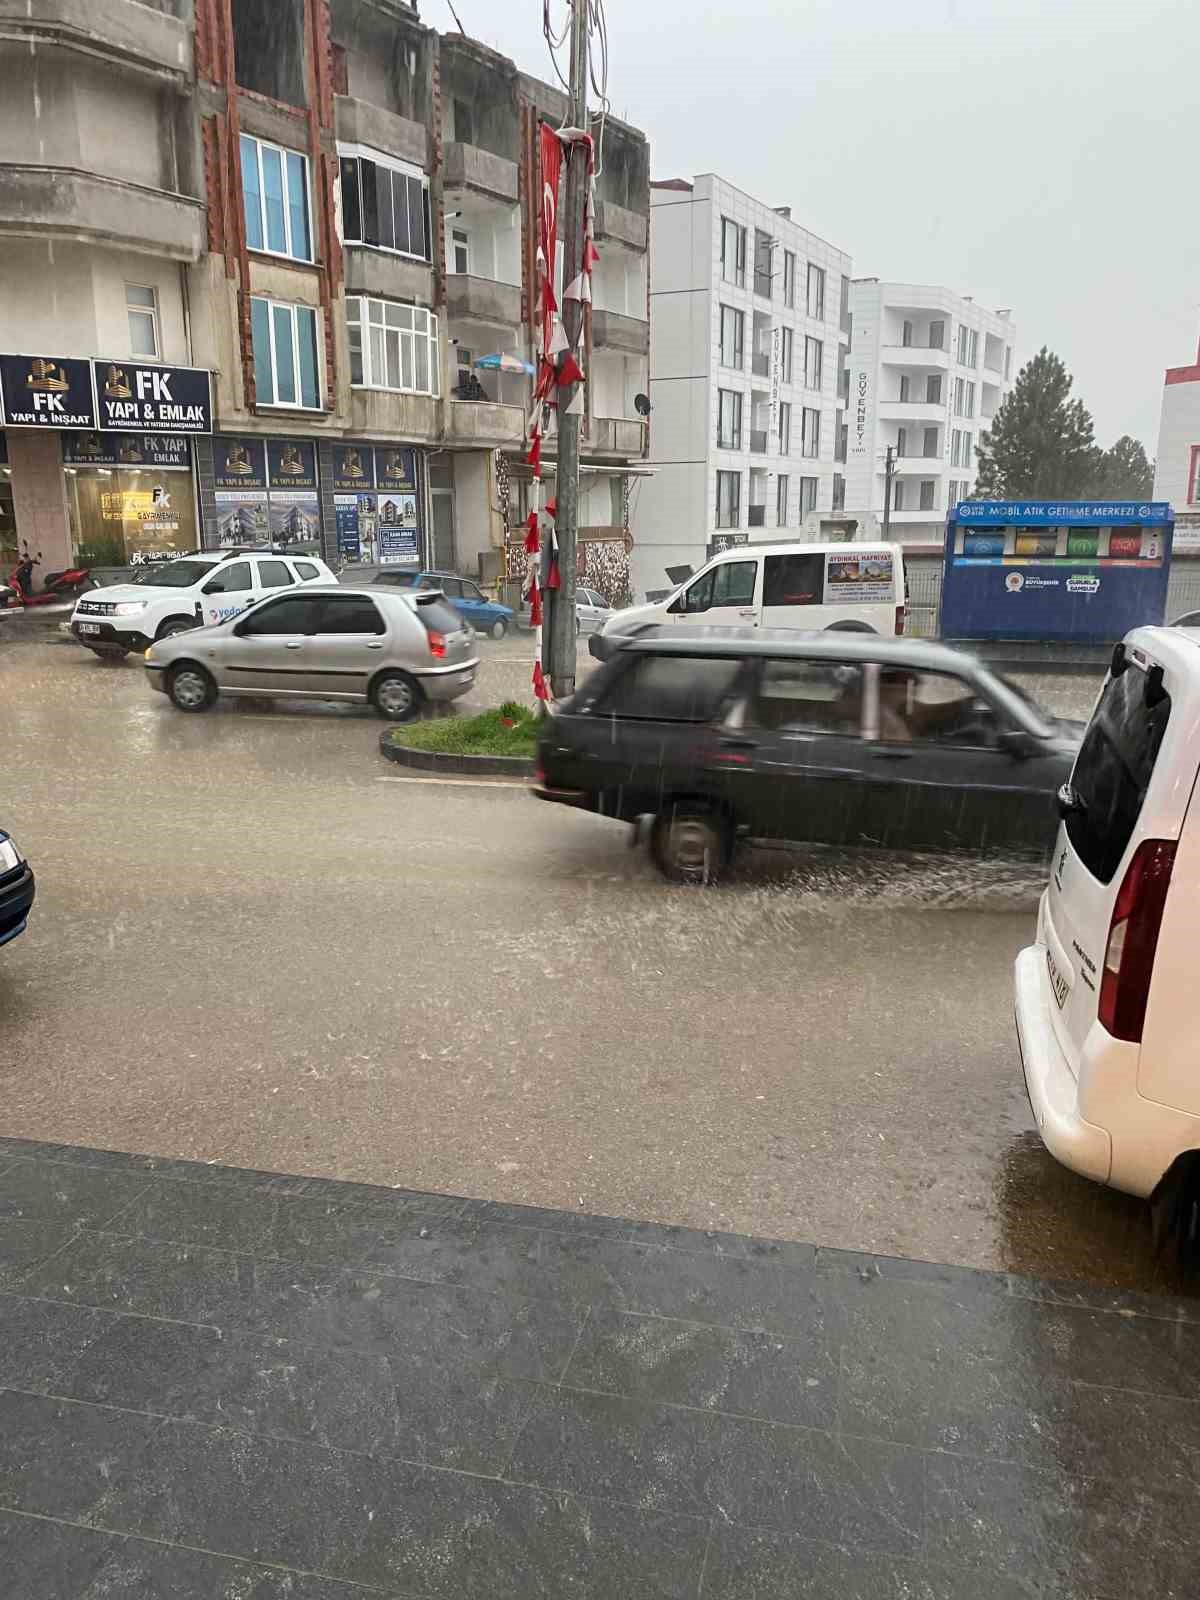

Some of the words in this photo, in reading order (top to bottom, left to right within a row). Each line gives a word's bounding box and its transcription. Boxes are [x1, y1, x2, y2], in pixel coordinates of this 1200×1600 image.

[136, 370, 173, 401] FK
[33, 392, 65, 411] FK
[11, 412, 36, 422] YAPI
[40, 414, 48, 423] &
[51, 412, 90, 425] İNŞAAT
[105, 400, 139, 419] YAPI
[143, 403, 155, 420] &
[159, 404, 205, 421] EMLAK
[143, 436, 158, 450] FK
[161, 438, 187, 452] YAPI
[154, 452, 180, 463] EMLAK
[990, 504, 1021, 516] MOBİL
[1023, 506, 1045, 516] ATIK
[1092, 506, 1135, 516] MERKEZİ
